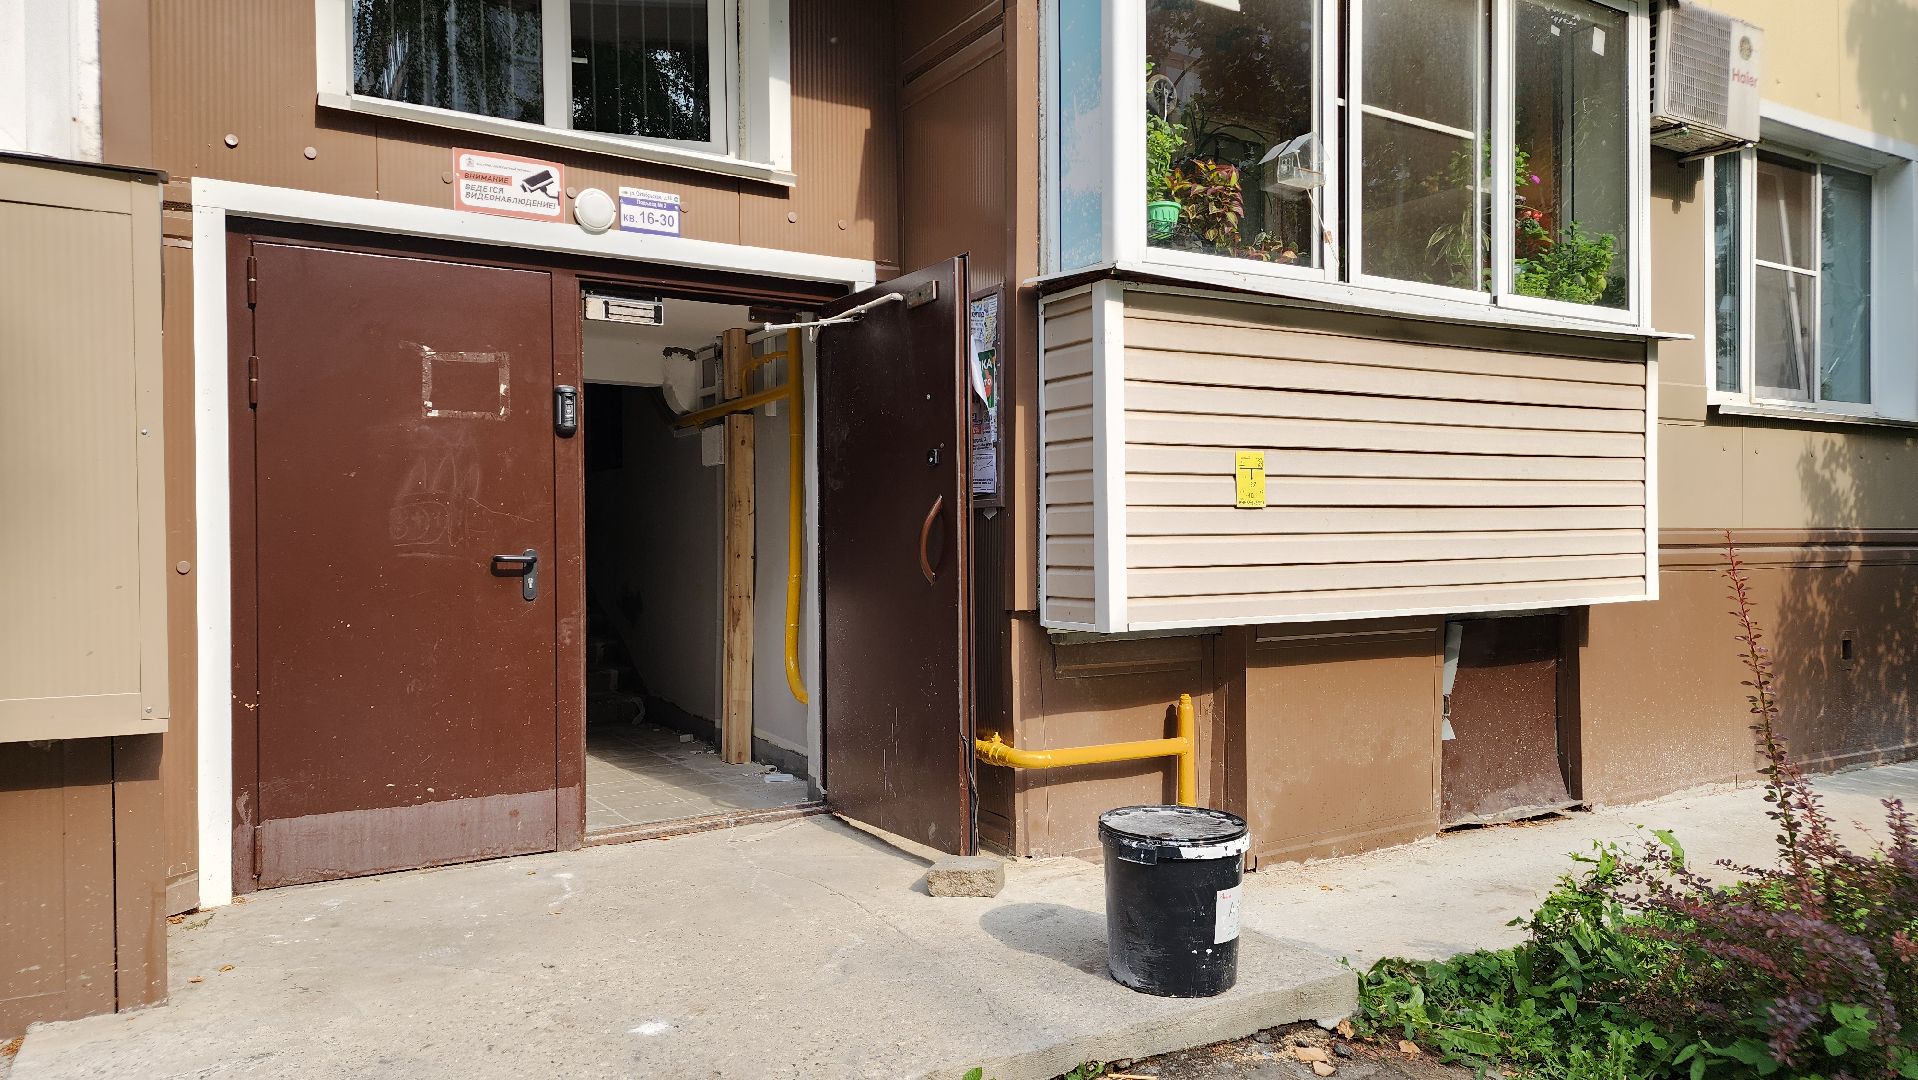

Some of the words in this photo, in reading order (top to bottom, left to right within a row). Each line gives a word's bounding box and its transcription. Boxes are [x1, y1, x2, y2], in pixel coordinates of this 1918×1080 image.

[1732, 68, 1758, 87] Haier
[464, 172, 509, 184] ВНИМАНИЕ
[465, 183, 504, 195] ВЕДЕТСЯ
[465, 191, 556, 210] ВИДЕОНАБЛЮДЕНИЕ!
